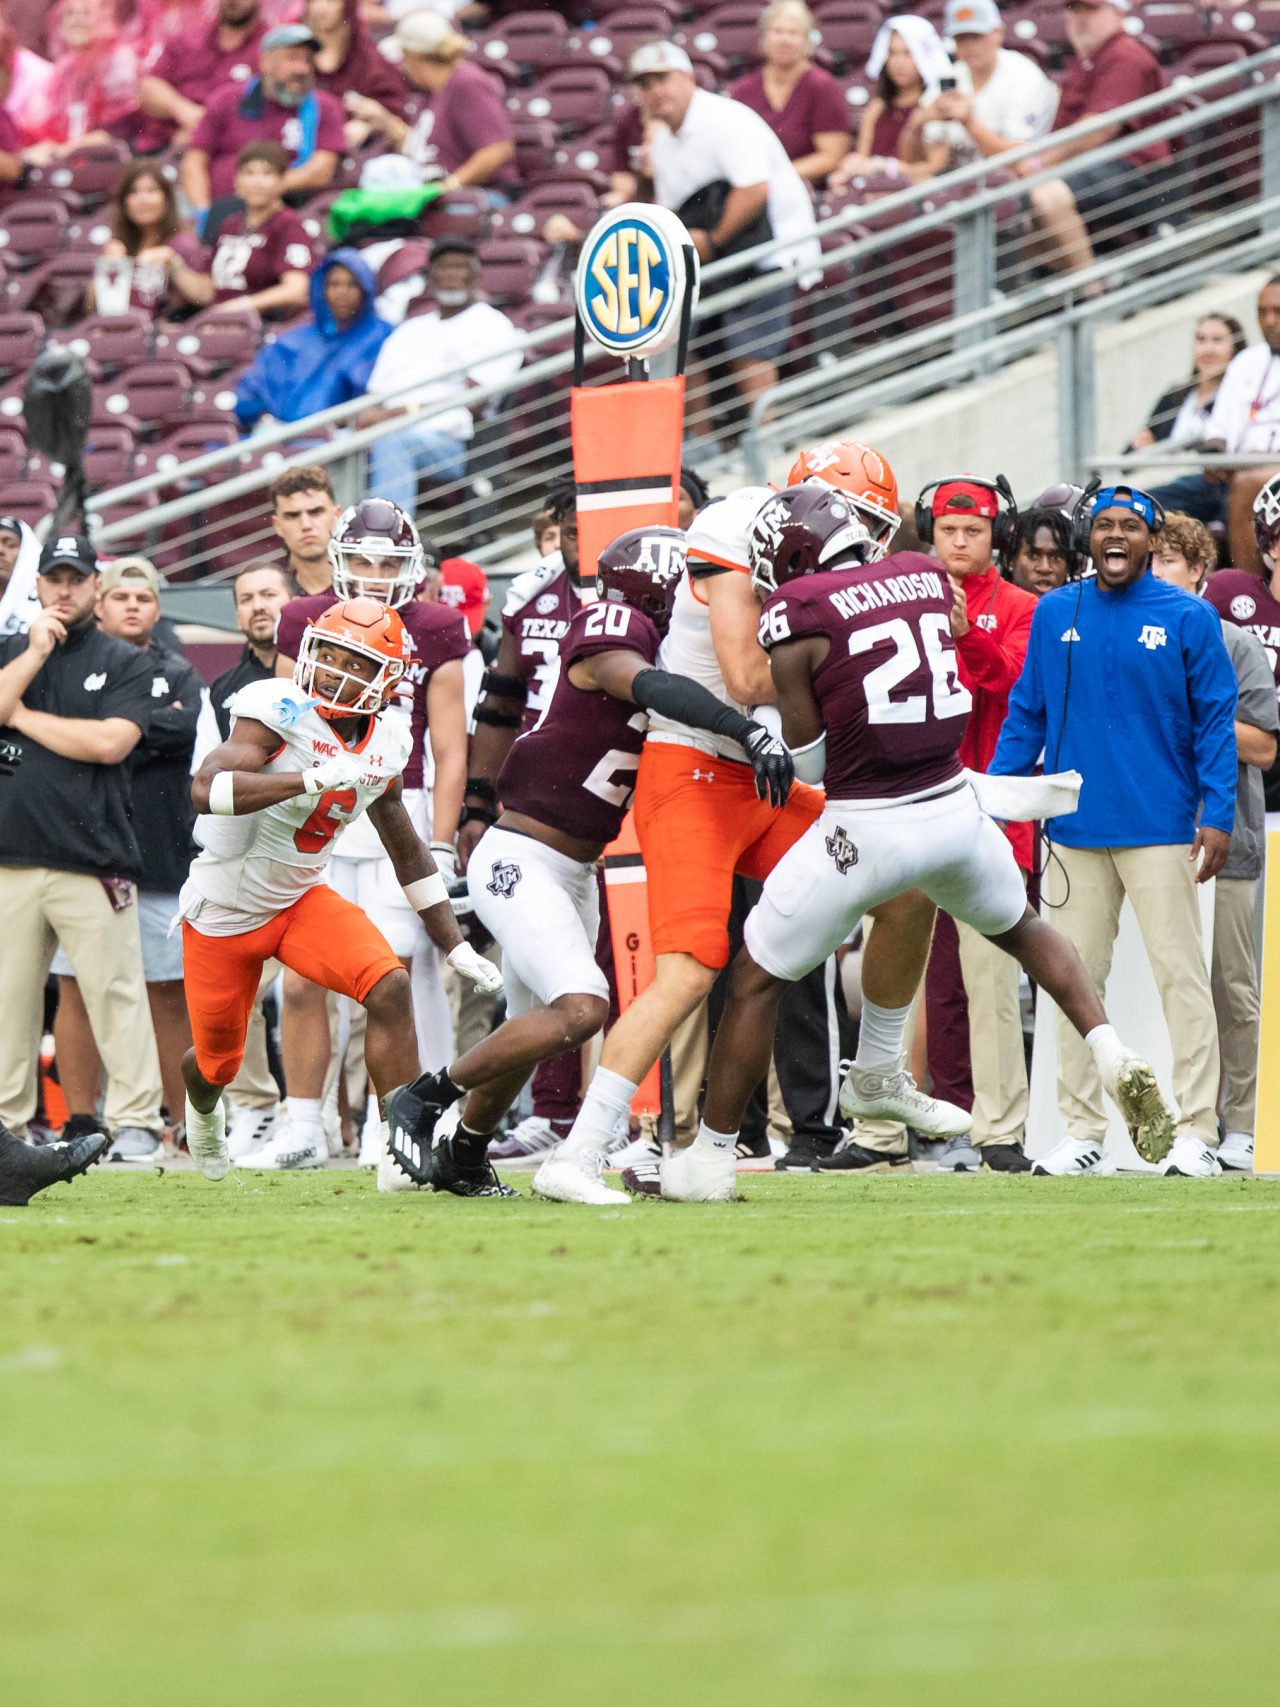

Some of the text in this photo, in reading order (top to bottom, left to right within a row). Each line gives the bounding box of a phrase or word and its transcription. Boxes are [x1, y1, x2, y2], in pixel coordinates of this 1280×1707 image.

[591, 227, 664, 335] SEC
[584, 602, 632, 637] 20
[828, 572, 945, 621] RICHARDSON
[757, 601, 792, 648] 26
[847, 612, 973, 724] 26
[311, 739, 339, 758] WAC
[293, 787, 358, 857] 6
